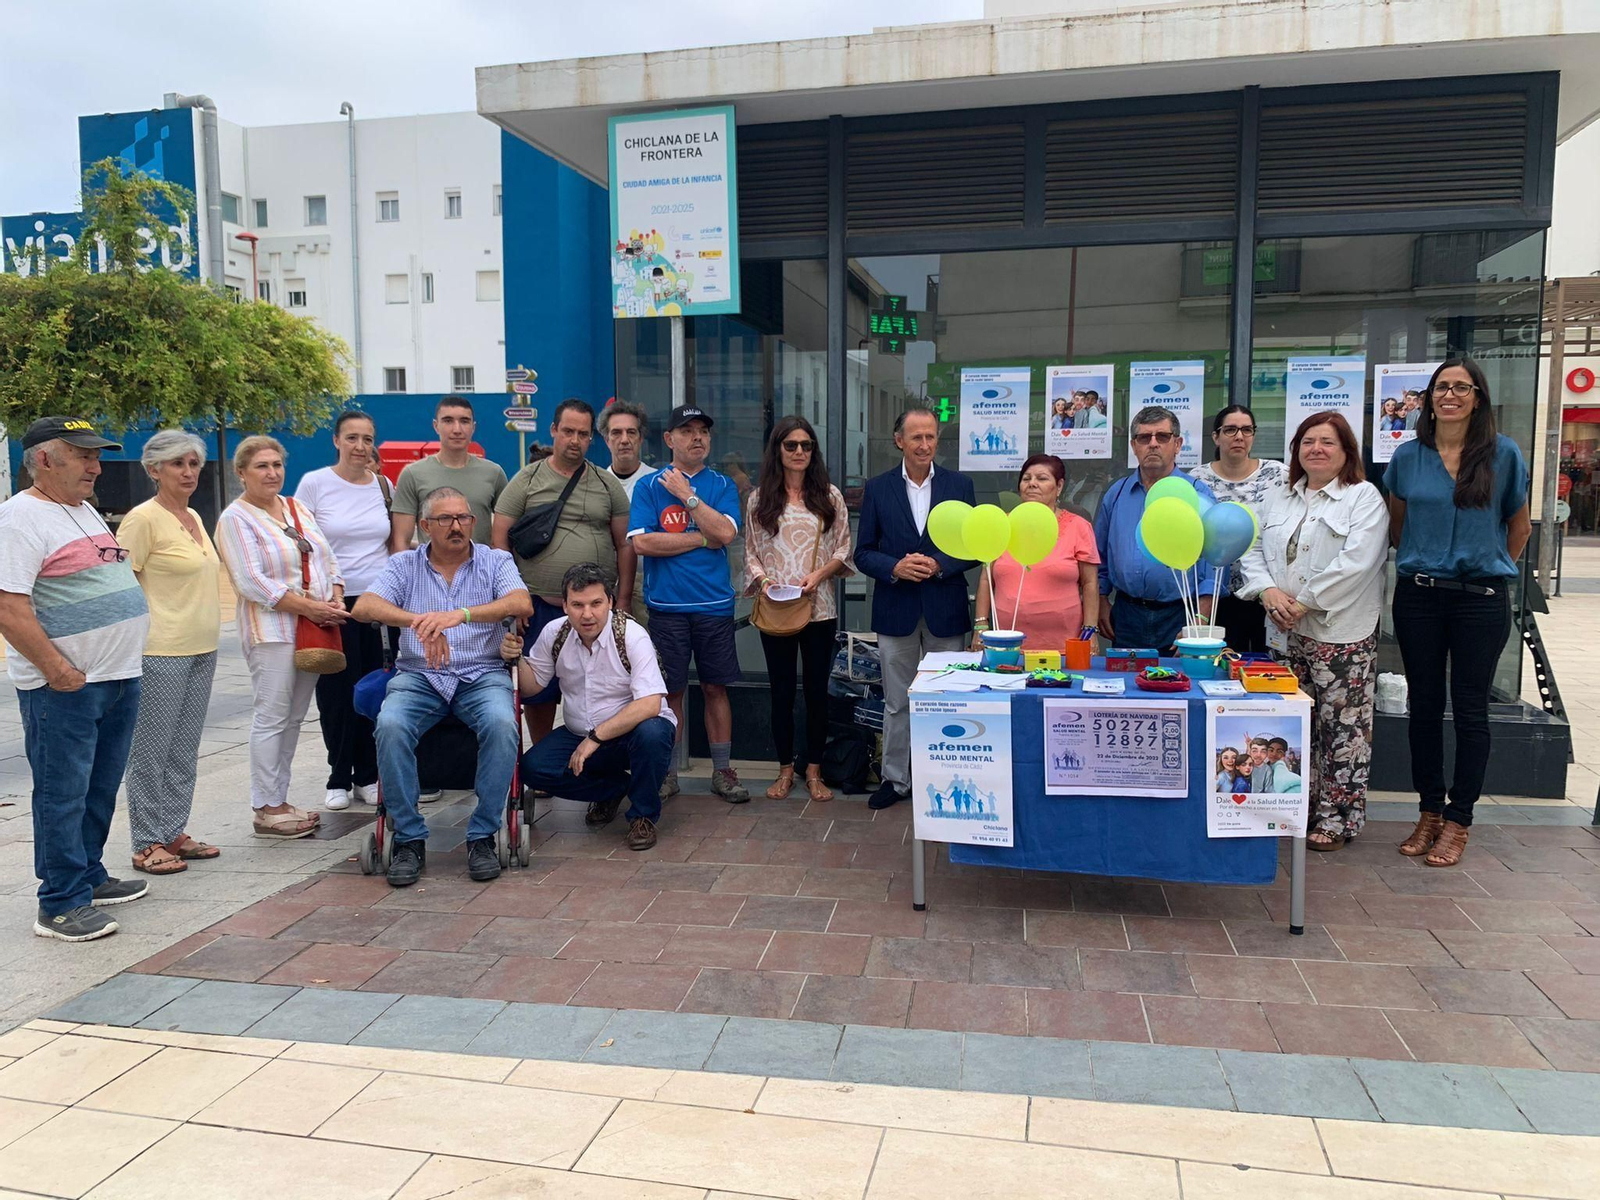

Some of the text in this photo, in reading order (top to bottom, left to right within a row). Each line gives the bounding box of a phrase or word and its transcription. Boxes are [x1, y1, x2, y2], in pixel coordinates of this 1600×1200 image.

[625, 132, 718, 149] CHICLANA DE LA
[641, 147, 702, 161] FRONTERA
[623, 180, 647, 188] CIUDAD
[649, 178, 670, 186] AMIGA
[691, 175, 722, 183] INFANCIA
[651, 203, 694, 214] 2021-2025
[928, 742, 992, 751] afemen
